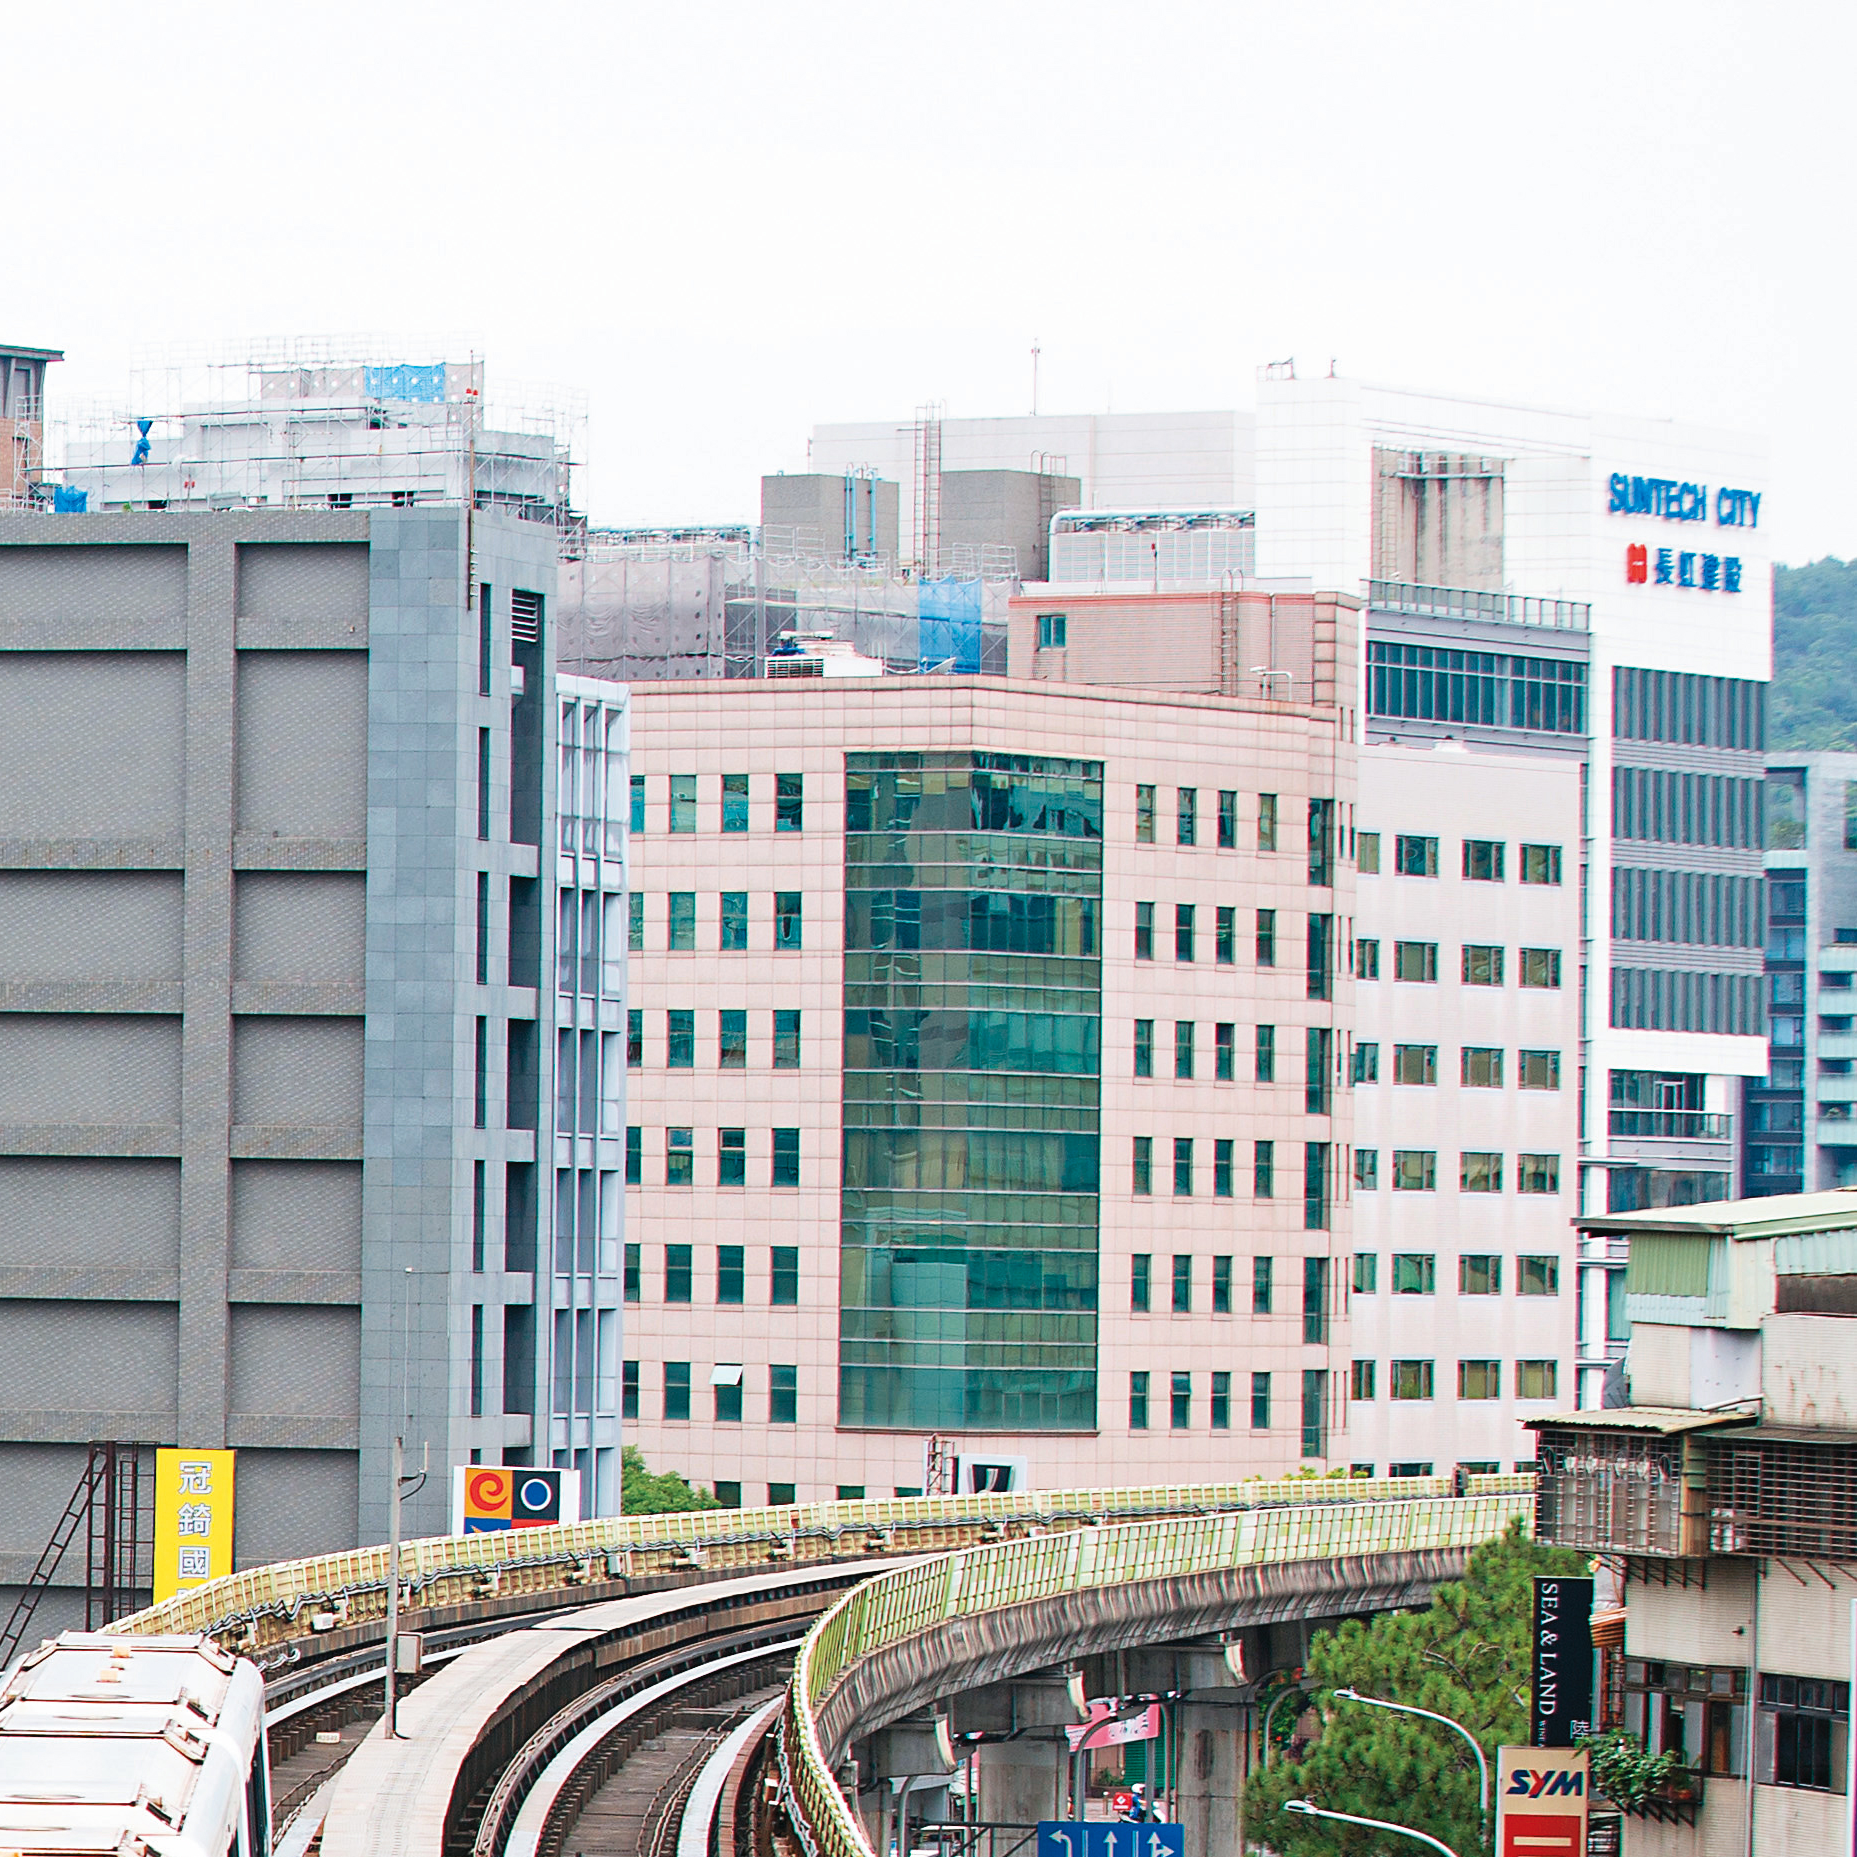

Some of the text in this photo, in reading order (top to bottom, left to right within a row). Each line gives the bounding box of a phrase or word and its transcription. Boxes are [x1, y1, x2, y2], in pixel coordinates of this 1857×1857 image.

[1609, 473, 1761, 528] SUNTECH CITY
[1541, 1583, 1559, 1626] SEA
[1540, 1630, 1558, 1647] &
[1539, 1652, 1558, 1716] LAND
[1505, 1769, 1584, 1798] SYM
